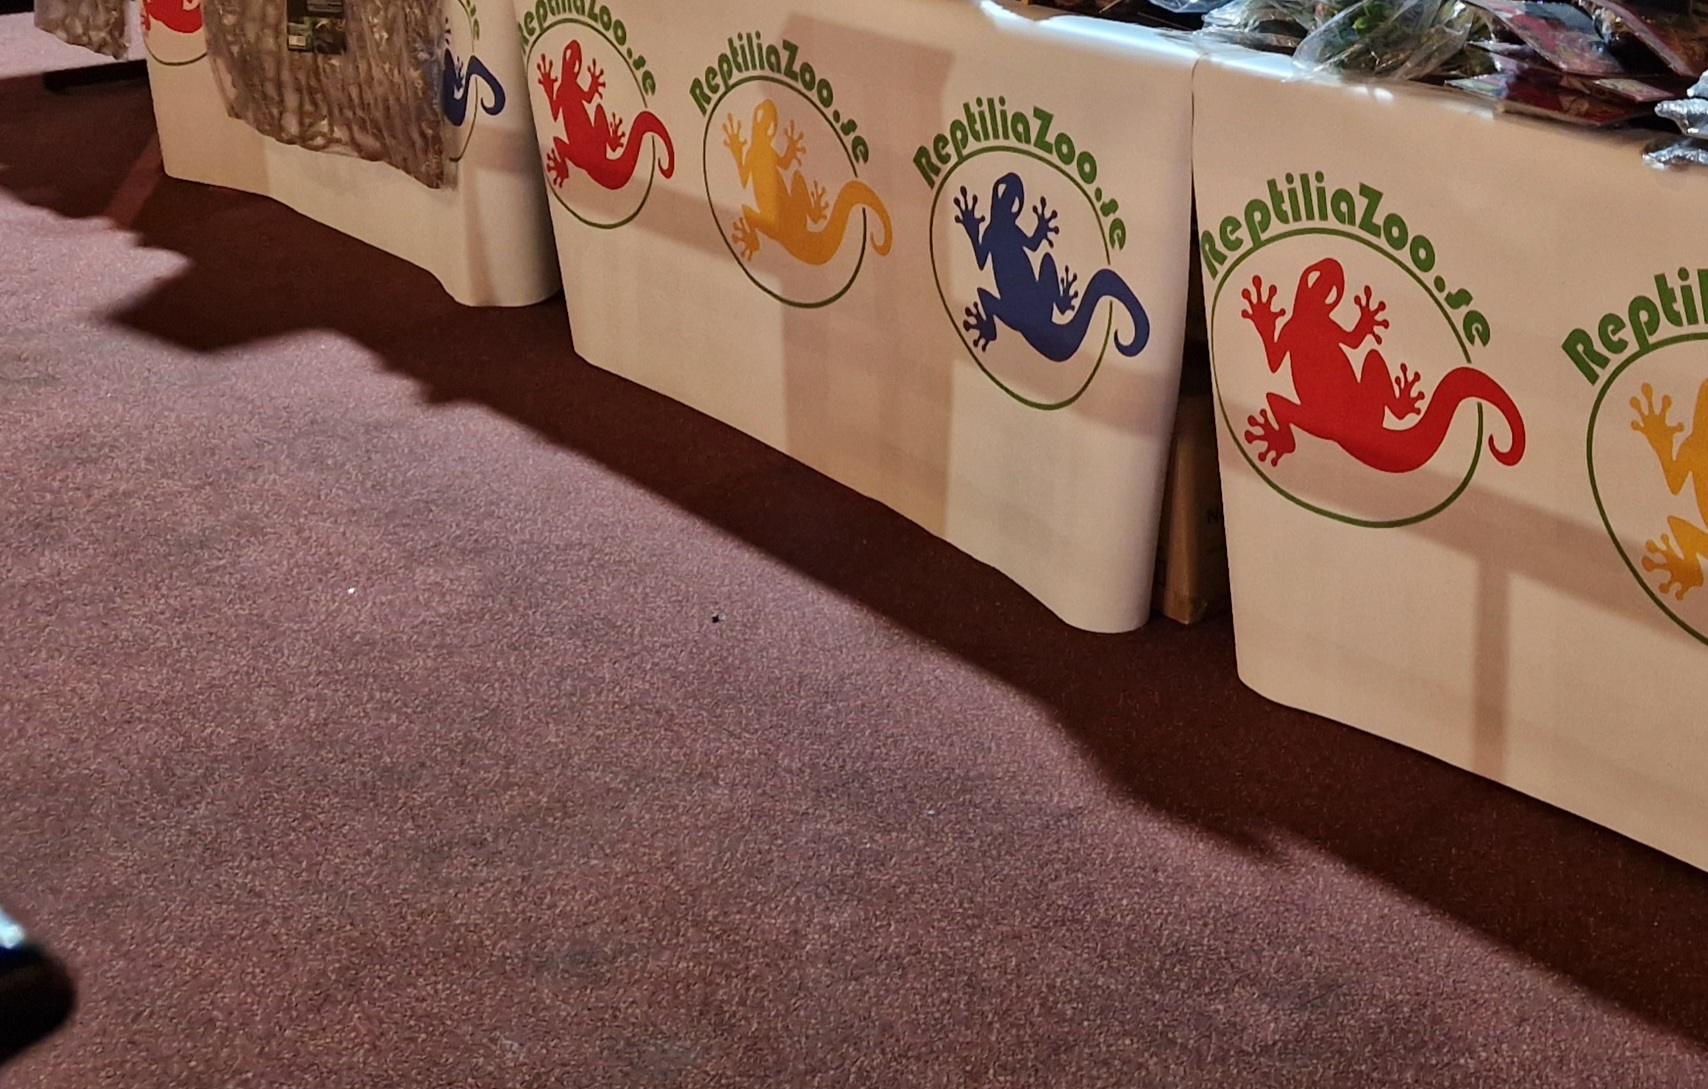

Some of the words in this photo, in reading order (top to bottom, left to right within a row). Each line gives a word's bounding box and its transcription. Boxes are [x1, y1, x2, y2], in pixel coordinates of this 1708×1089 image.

[689, 31, 870, 166] ReptiliaZoo.se
[913, 96, 1126, 252] ReptiliaZoo.se
[1200, 170, 1491, 348] ReptiliaZoo.se
